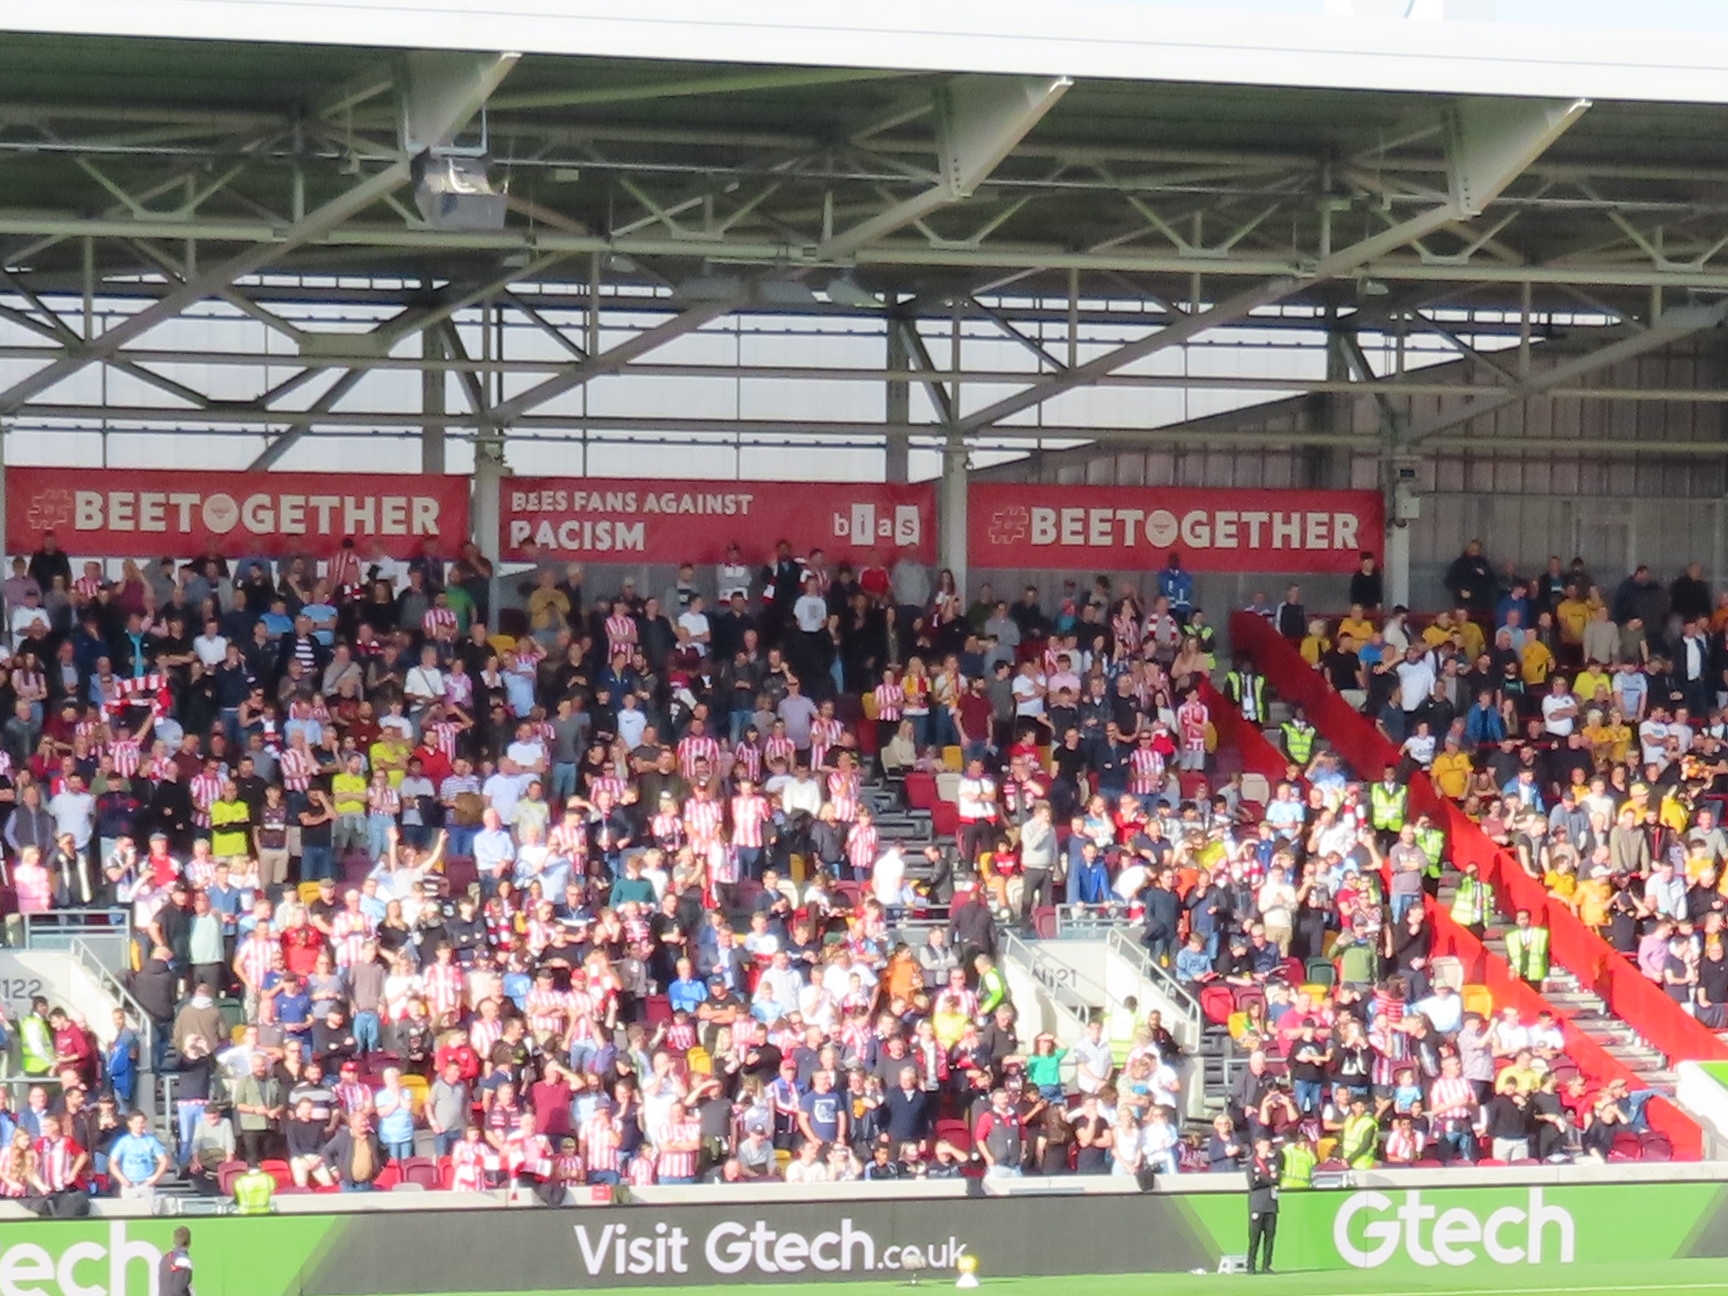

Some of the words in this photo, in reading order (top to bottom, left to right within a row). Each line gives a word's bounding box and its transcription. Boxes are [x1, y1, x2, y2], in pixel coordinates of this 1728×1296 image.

[511, 491, 568, 513] BEES
[574, 491, 638, 514] FANS
[642, 493, 753, 516] AGAINST
[510, 520, 645, 552] RACISM
[573, 1221, 690, 1276] Visit
[1332, 1186, 1575, 1268] Gtech
